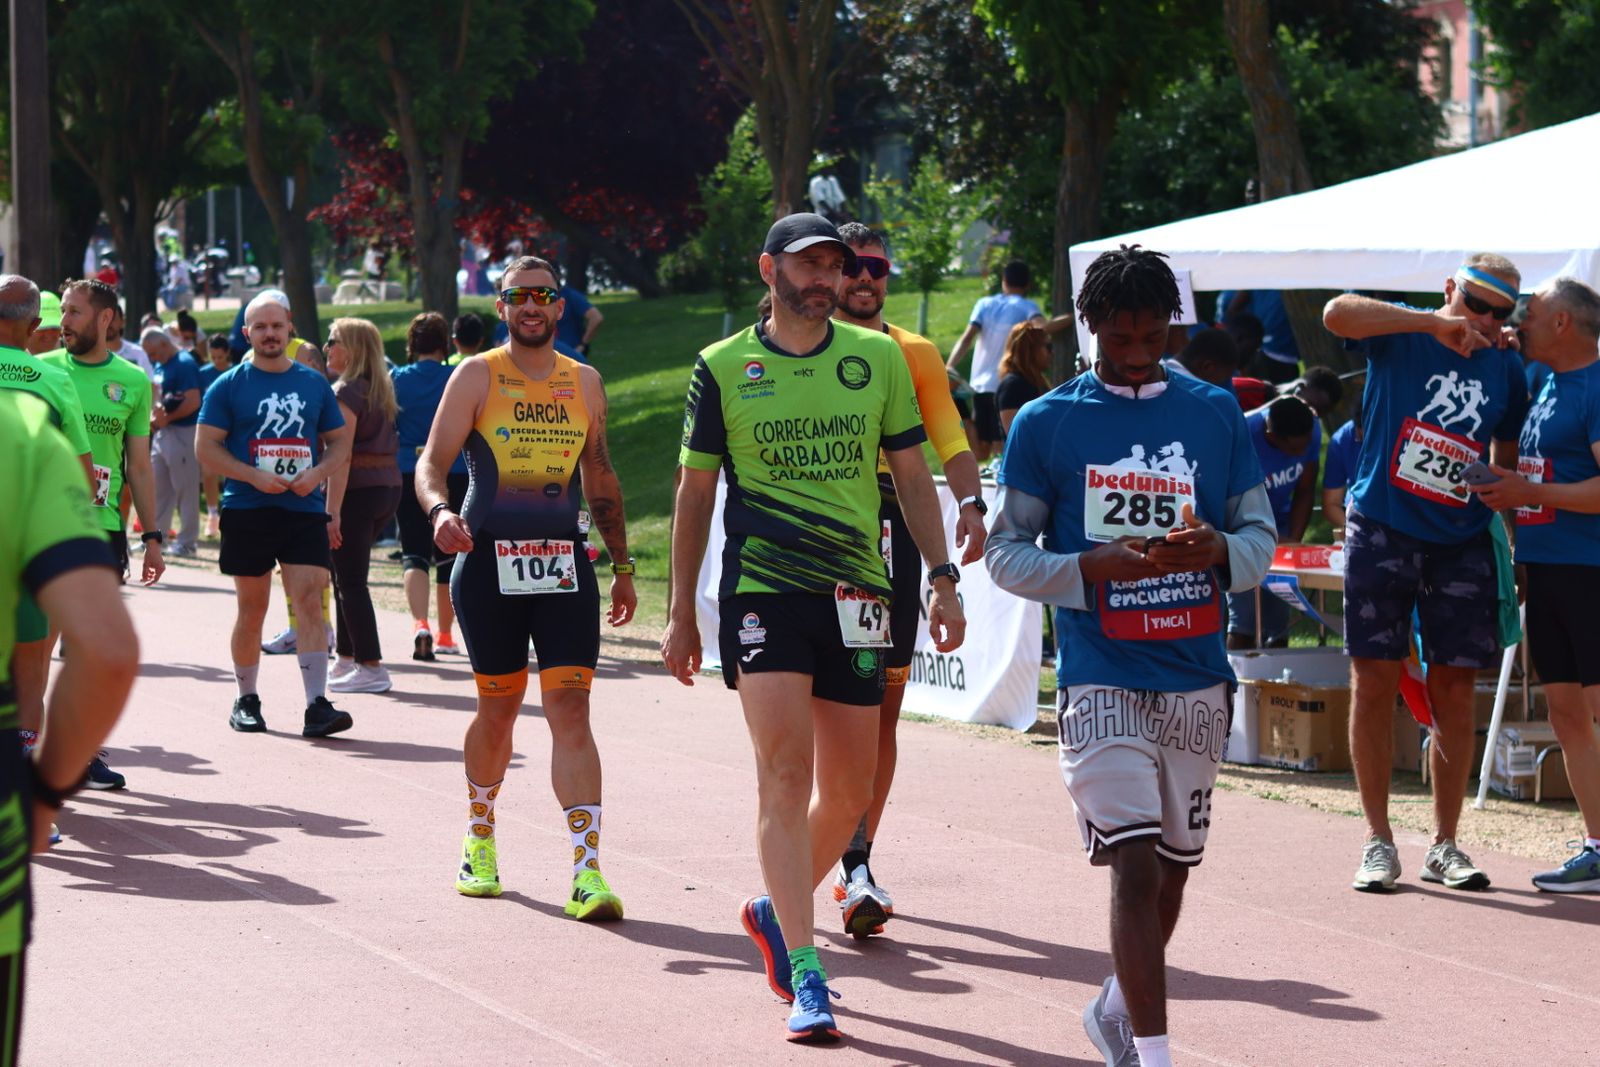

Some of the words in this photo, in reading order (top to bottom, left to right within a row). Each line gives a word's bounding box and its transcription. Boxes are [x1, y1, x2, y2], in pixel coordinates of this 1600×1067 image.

[519, 436, 576, 445] SALMANTINA
[753, 414, 866, 444] CORRECAMINOS
[260, 448, 311, 458] bedunia
[760, 440, 864, 467] CARBAJOSA
[274, 458, 297, 475] 66
[769, 467, 860, 481] SALAMANCA
[1414, 449, 1466, 484] 238
[1088, 469, 1192, 496] bedunia
[1103, 491, 1176, 528] 285
[497, 543, 572, 557] bedunia
[511, 556, 564, 581] 104
[1109, 582, 1212, 608] encuentro
[858, 602, 882, 631] 49
[1064, 688, 1227, 763] CHICAGO
